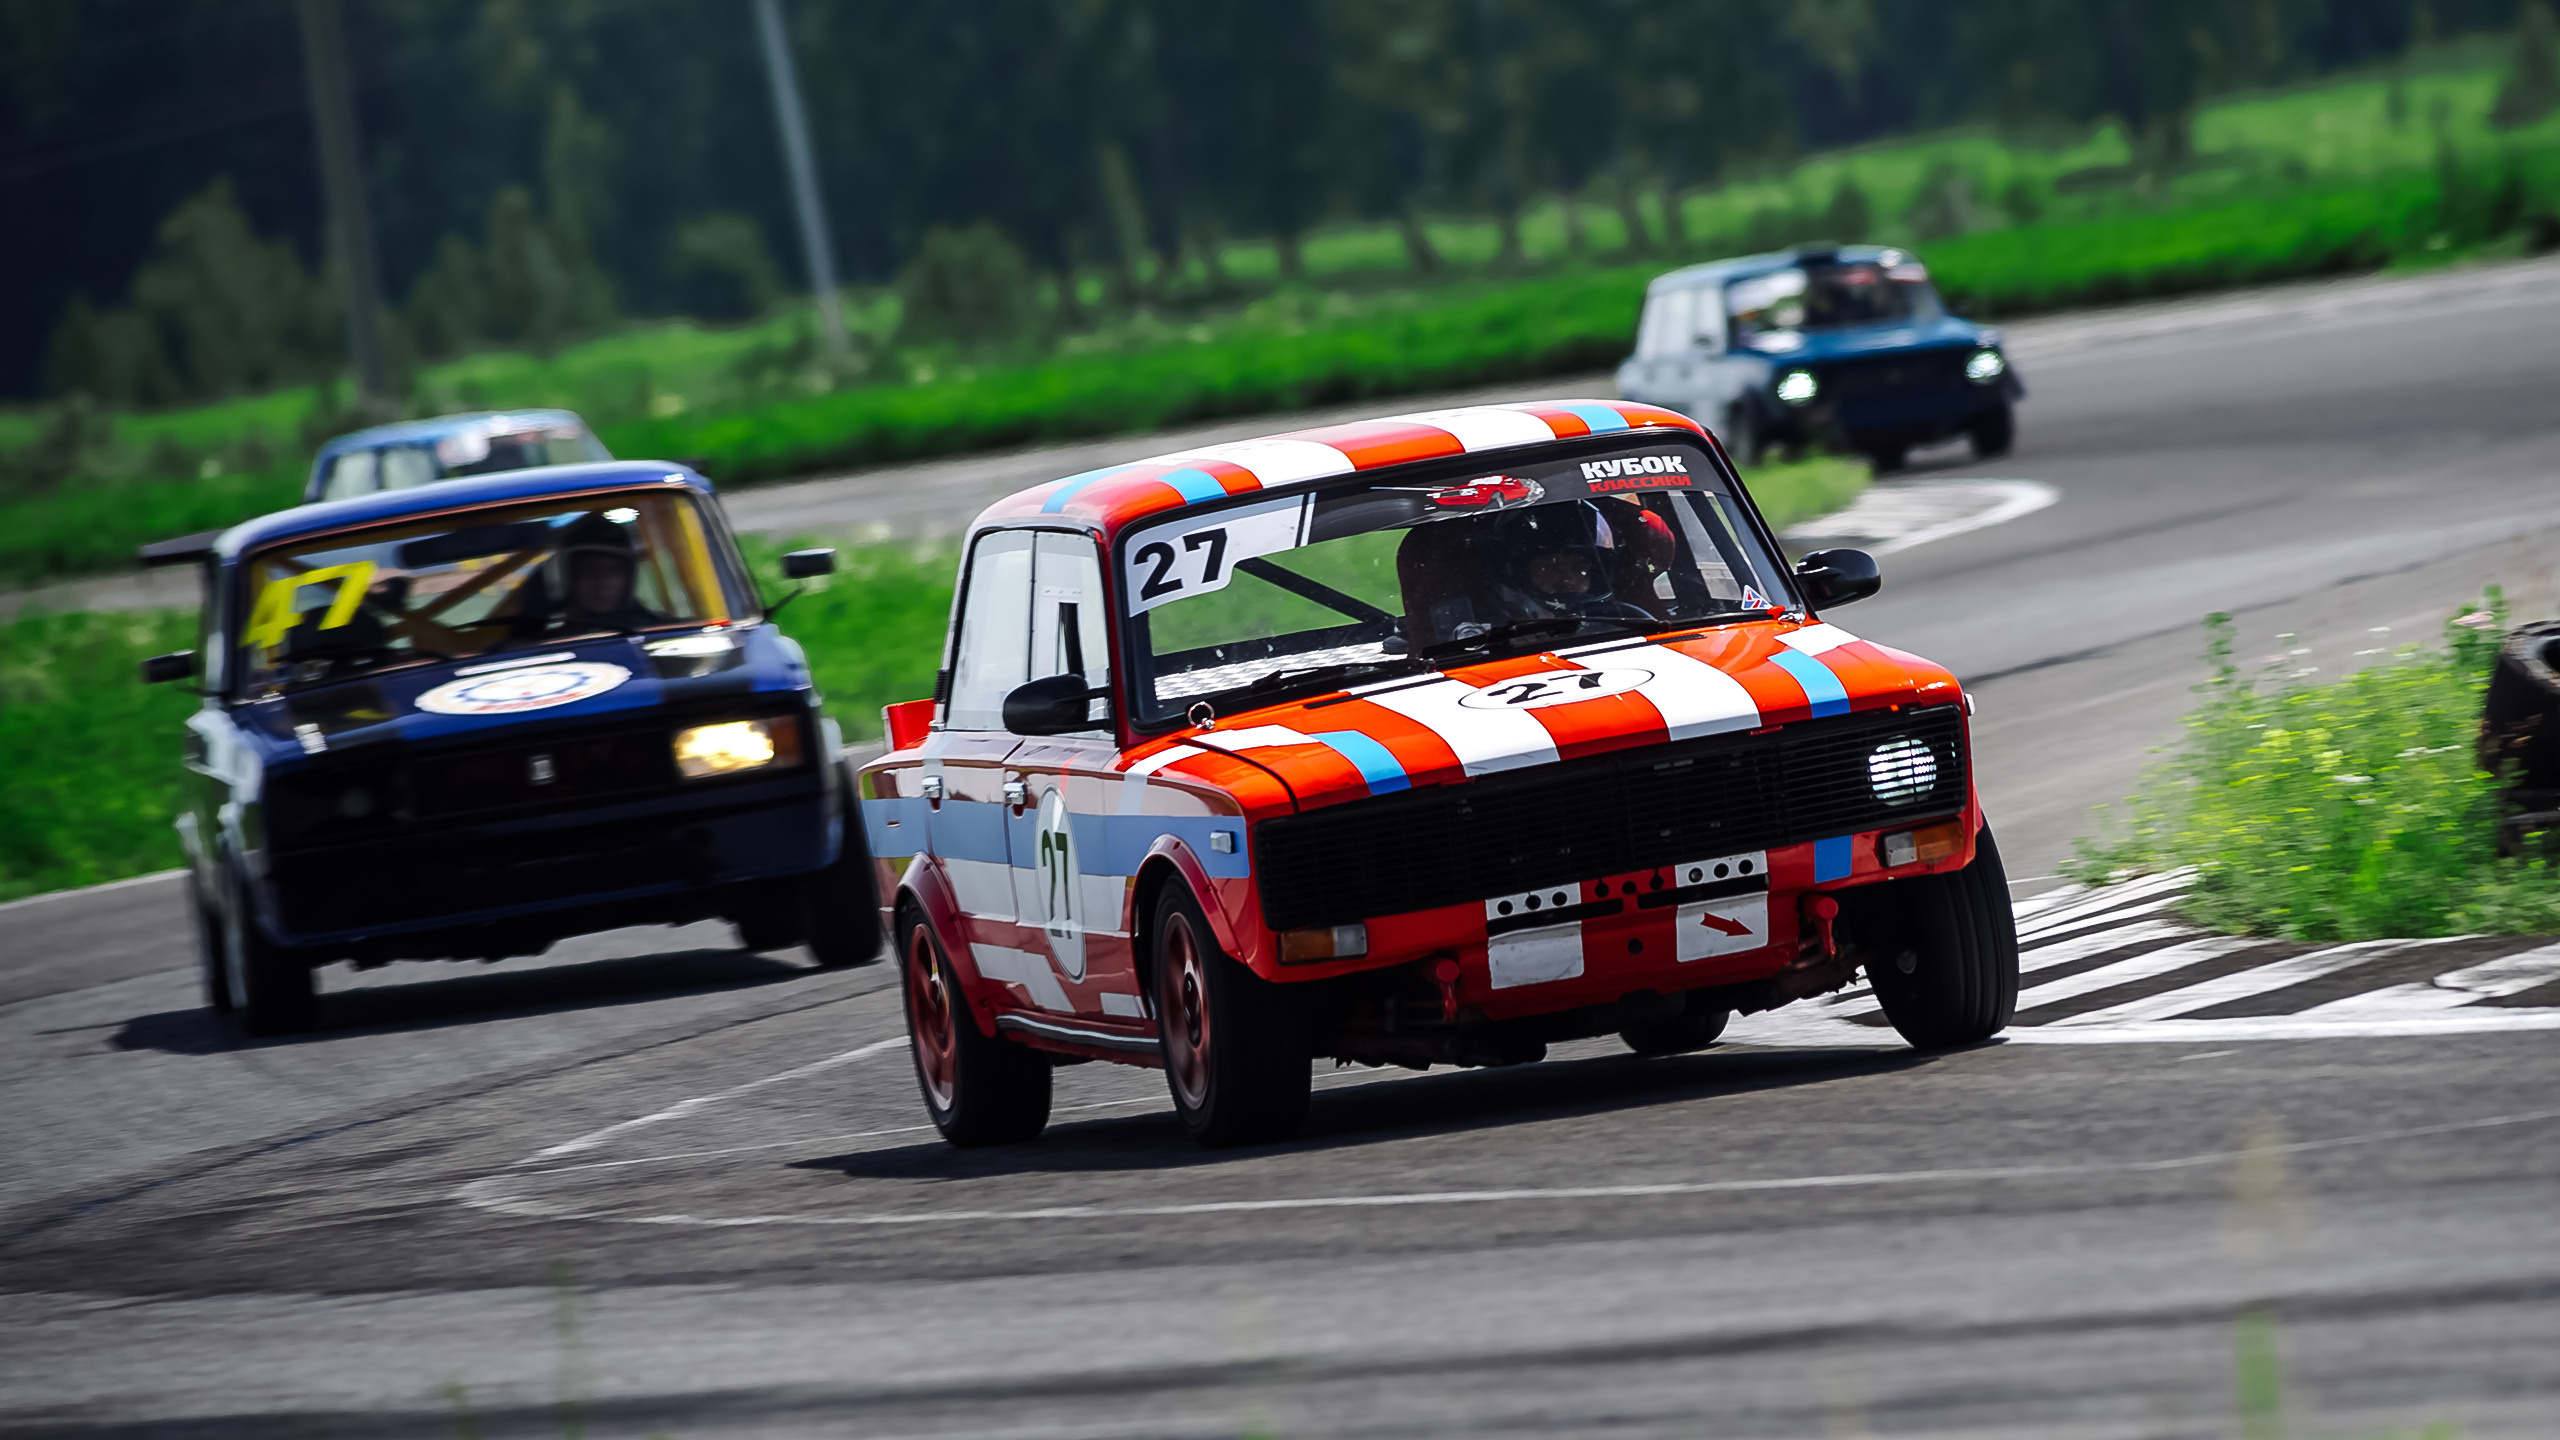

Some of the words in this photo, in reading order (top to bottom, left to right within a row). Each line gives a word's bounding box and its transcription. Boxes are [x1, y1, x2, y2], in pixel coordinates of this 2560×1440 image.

[1580, 456, 1687, 479] КУБОК
[1588, 475, 1692, 493] КЛАССИКИ
[1133, 527, 1228, 602] 27
[239, 560, 378, 649] 47
[1487, 672, 1604, 705] 27
[1041, 829, 1072, 939] 27
